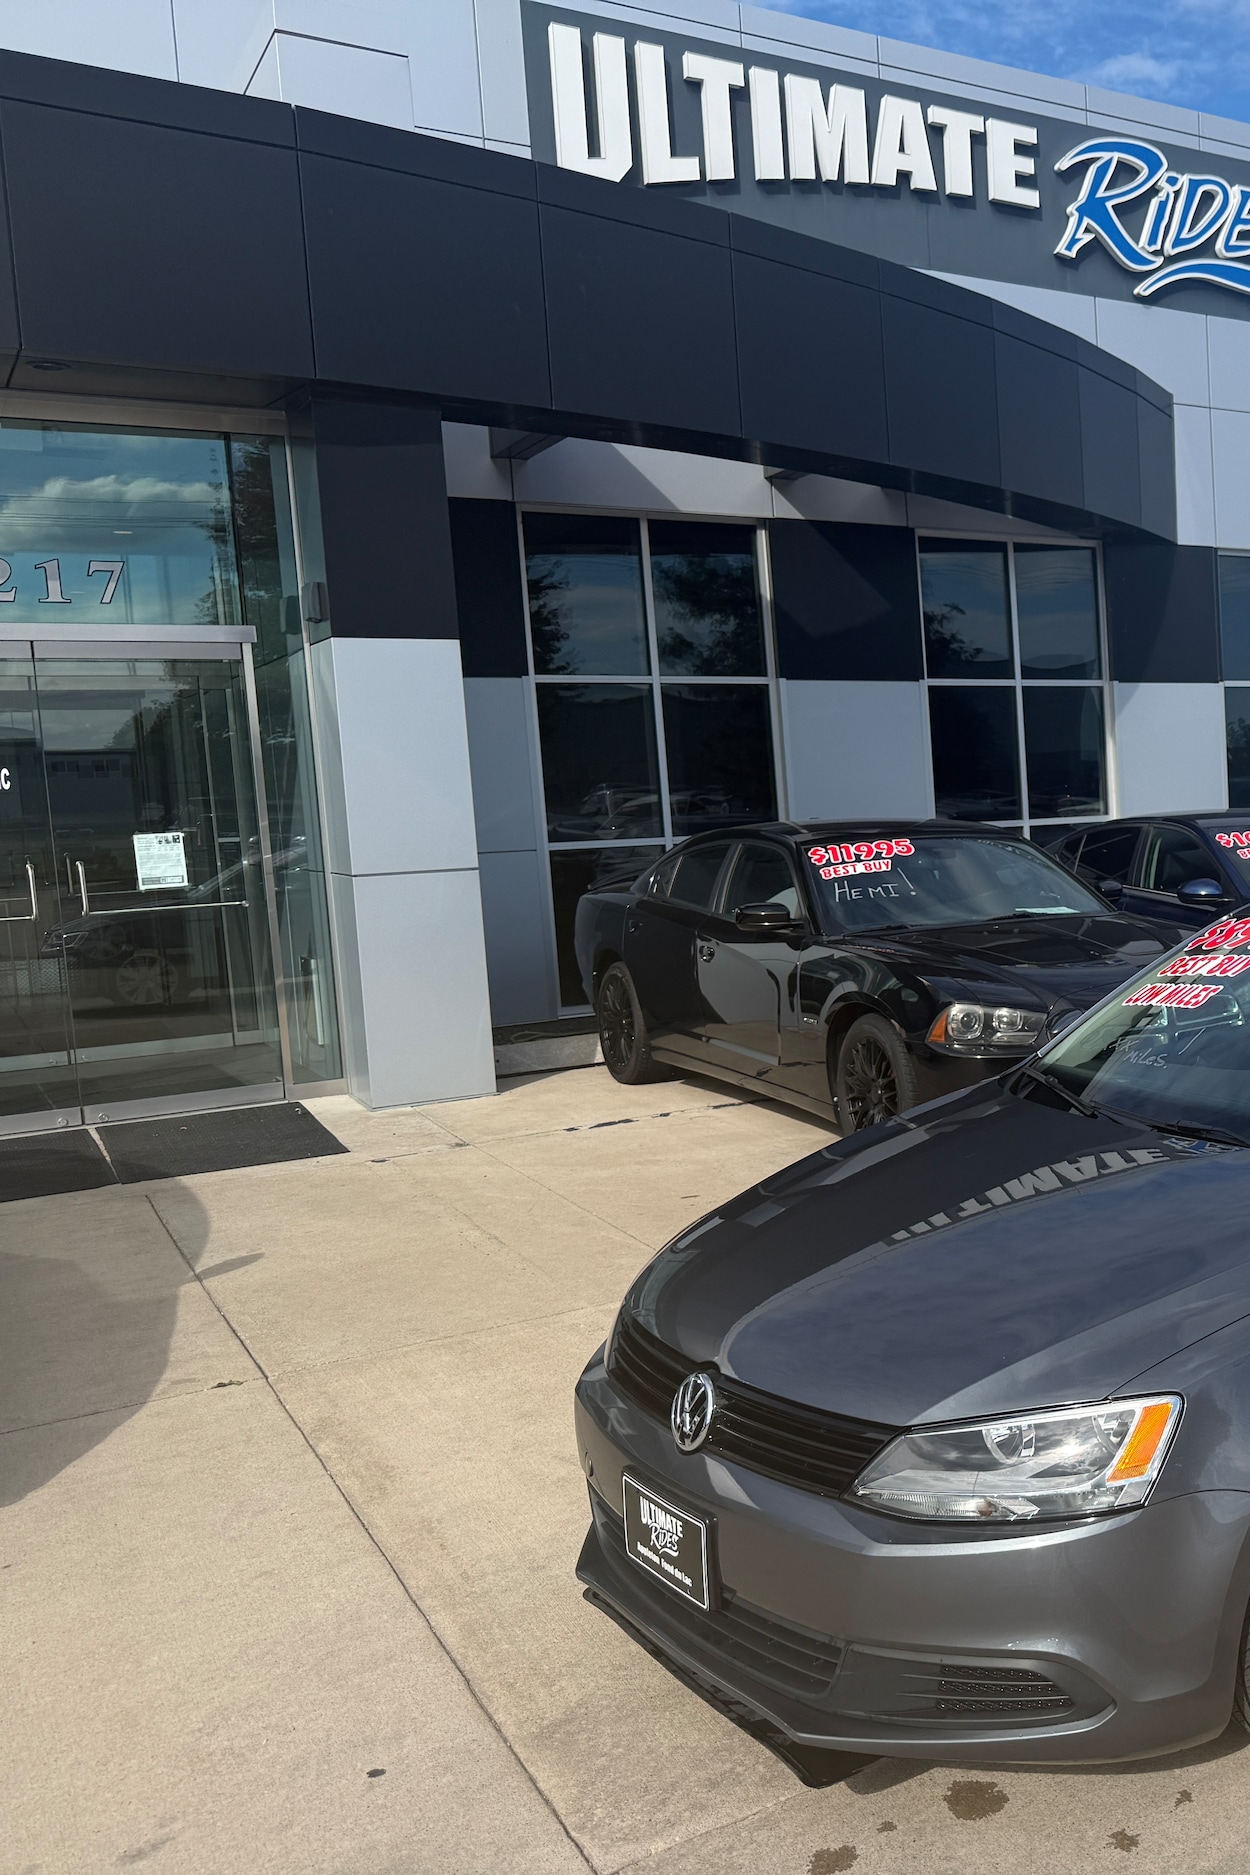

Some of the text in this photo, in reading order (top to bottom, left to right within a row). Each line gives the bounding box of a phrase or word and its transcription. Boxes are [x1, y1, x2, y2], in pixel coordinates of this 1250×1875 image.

[548, 22, 1040, 209] ULTIMATE
[808, 839, 914, 864] $11995
[820, 859, 892, 880] BEST BUY
[1157, 955, 1218, 977] BEST
[1122, 983, 1224, 1008] LOW MILES
[639, 1495, 684, 1538] ULTIMATE
